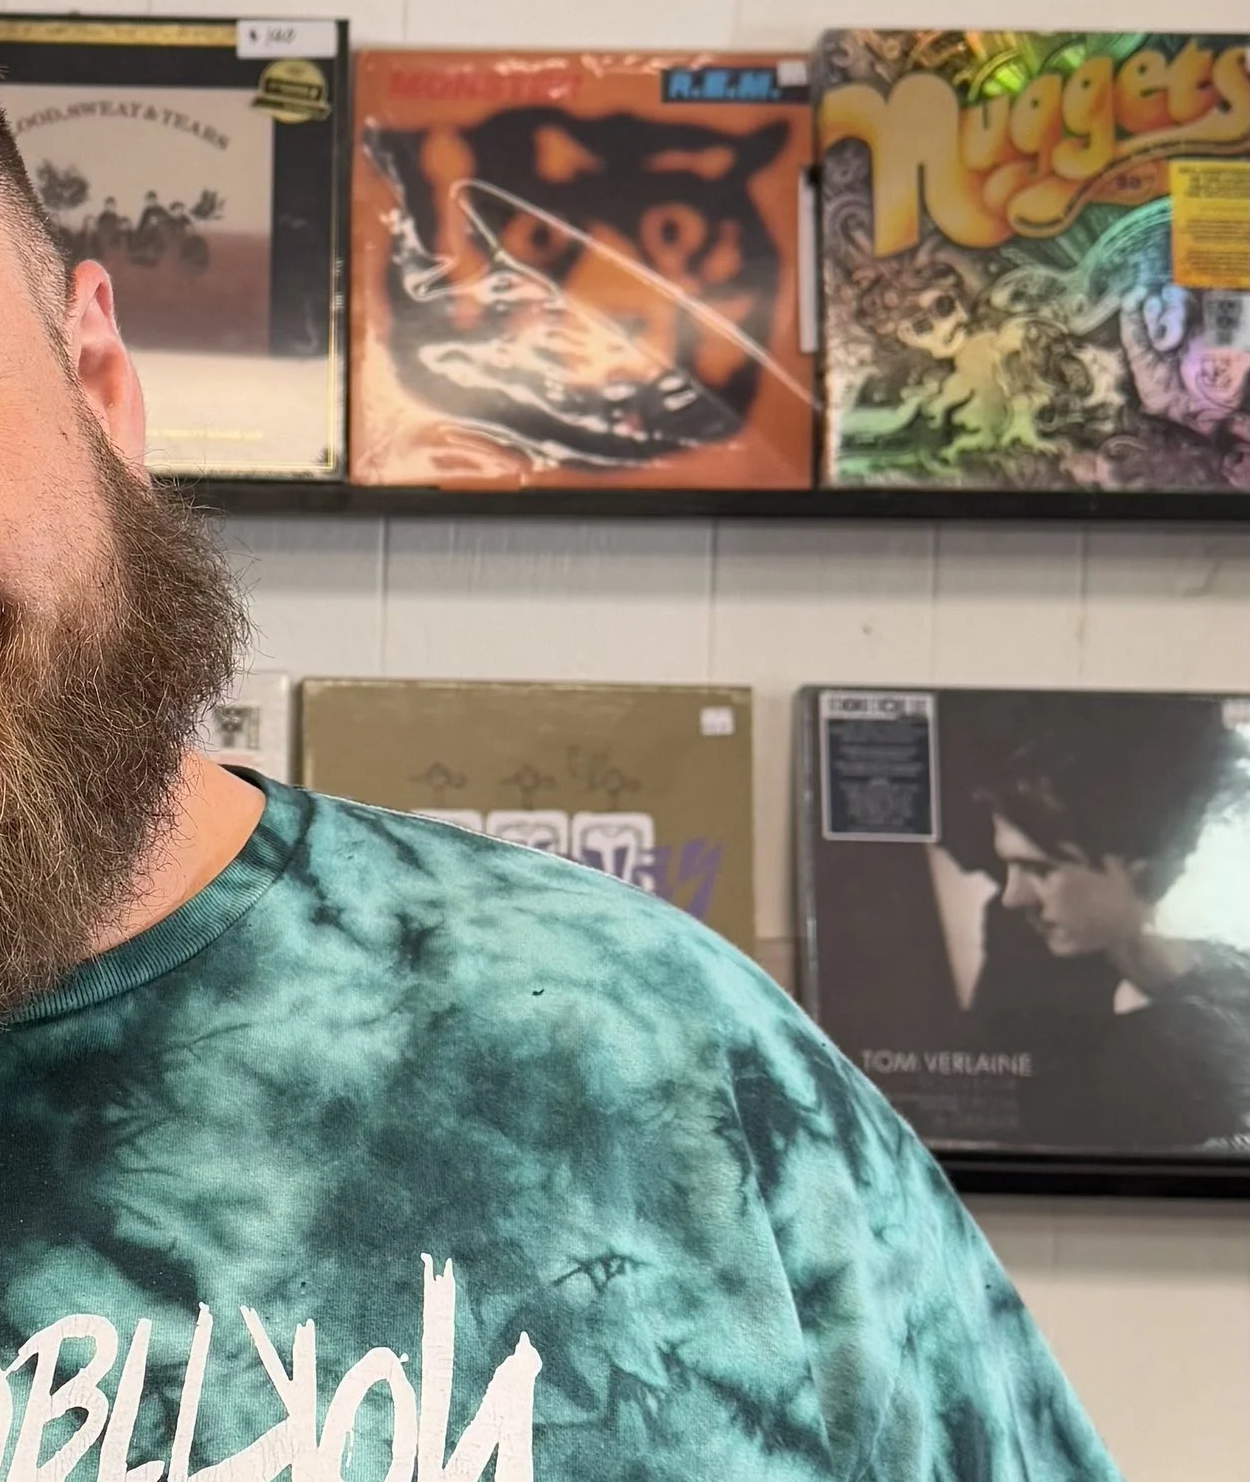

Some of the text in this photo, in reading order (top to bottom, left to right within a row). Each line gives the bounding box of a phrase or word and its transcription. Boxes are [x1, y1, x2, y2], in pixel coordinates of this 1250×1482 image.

[667, 70, 783, 100] R.E.M.
[860, 1048, 1034, 1078] TOM VERLAINE
